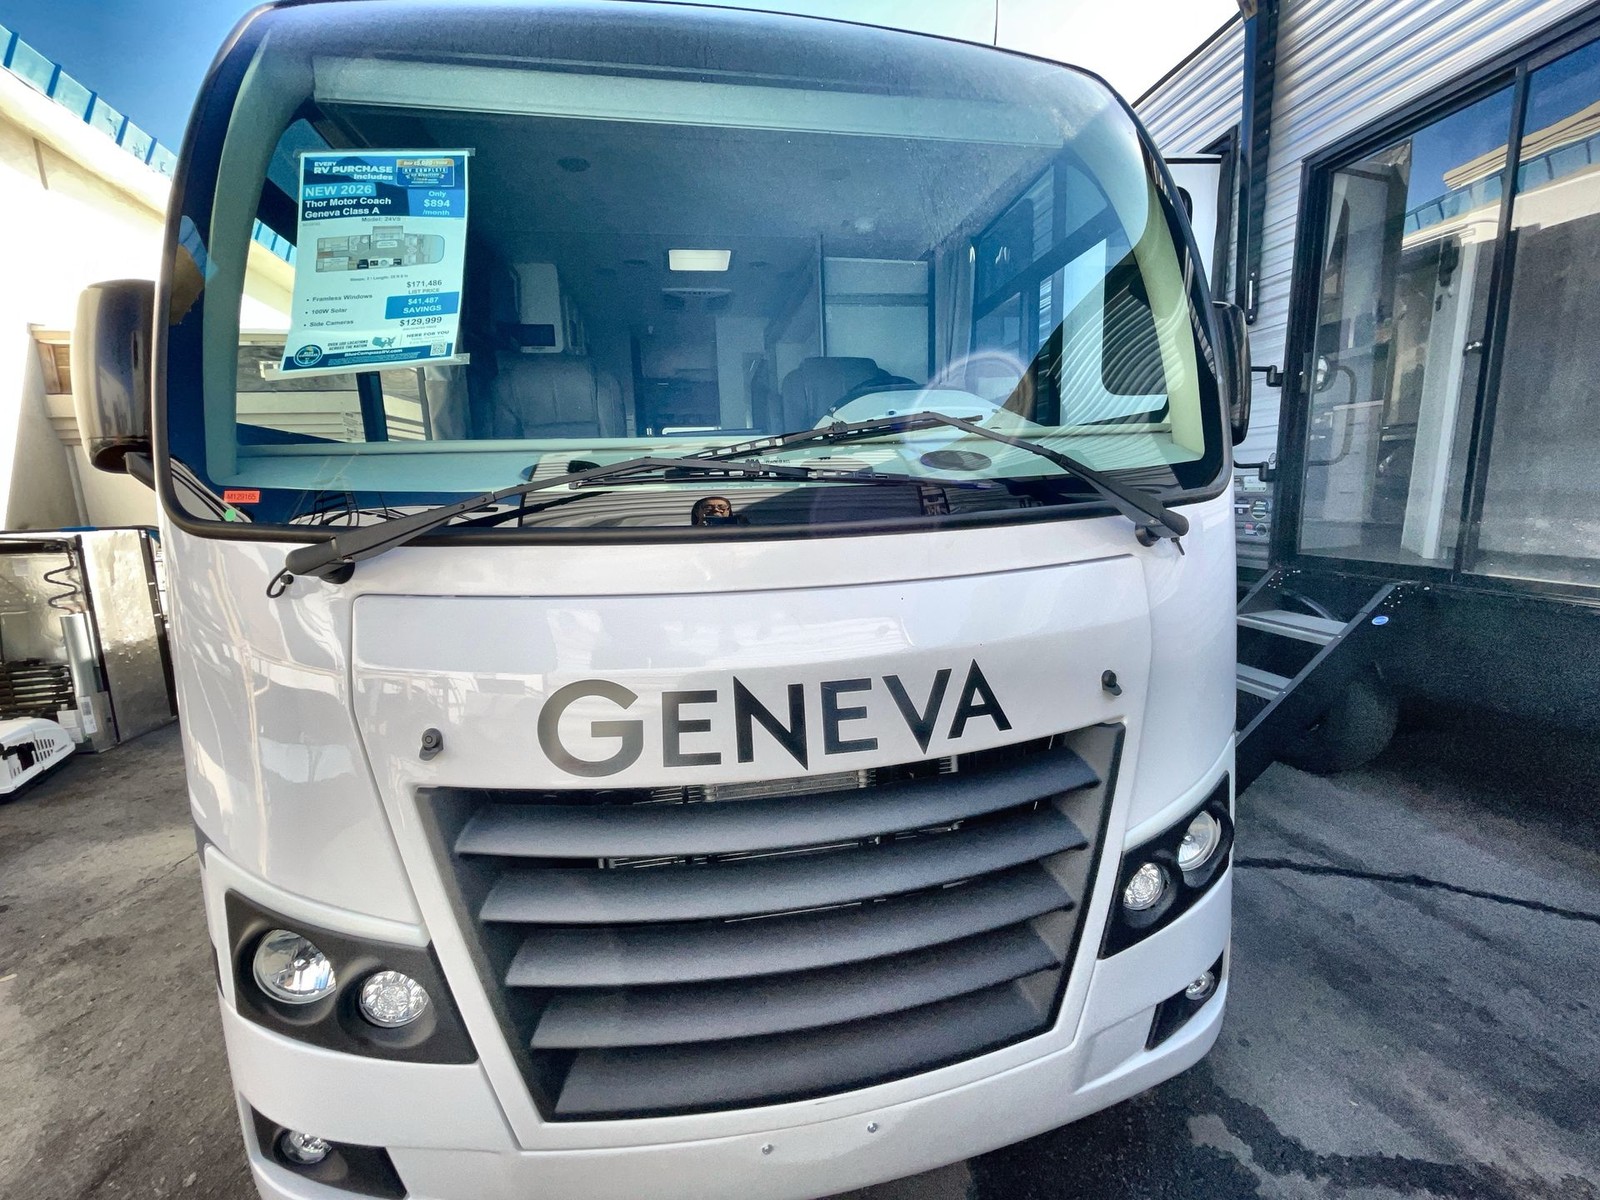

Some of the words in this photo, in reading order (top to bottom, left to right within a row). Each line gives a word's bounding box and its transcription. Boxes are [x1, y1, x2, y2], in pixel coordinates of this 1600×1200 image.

[313, 166, 330, 174] RV
[332, 165, 393, 173] PURCHASE
[305, 186, 337, 197] NEW
[340, 184, 372, 195] 2026
[428, 190, 446, 198] Only
[305, 200, 328, 208] Thor
[329, 198, 358, 206] Motor
[360, 197, 392, 205] Coach
[423, 199, 450, 208] $894
[304, 210, 340, 219] Geneva
[342, 207, 370, 216] Class
[371, 206, 380, 215] A
[406, 279, 442, 288] $171,486
[407, 296, 439, 305] $41,487
[402, 304, 442, 314] SAVINGS
[399, 316, 443, 327] $129,999
[537, 658, 1013, 778] GENEVA
